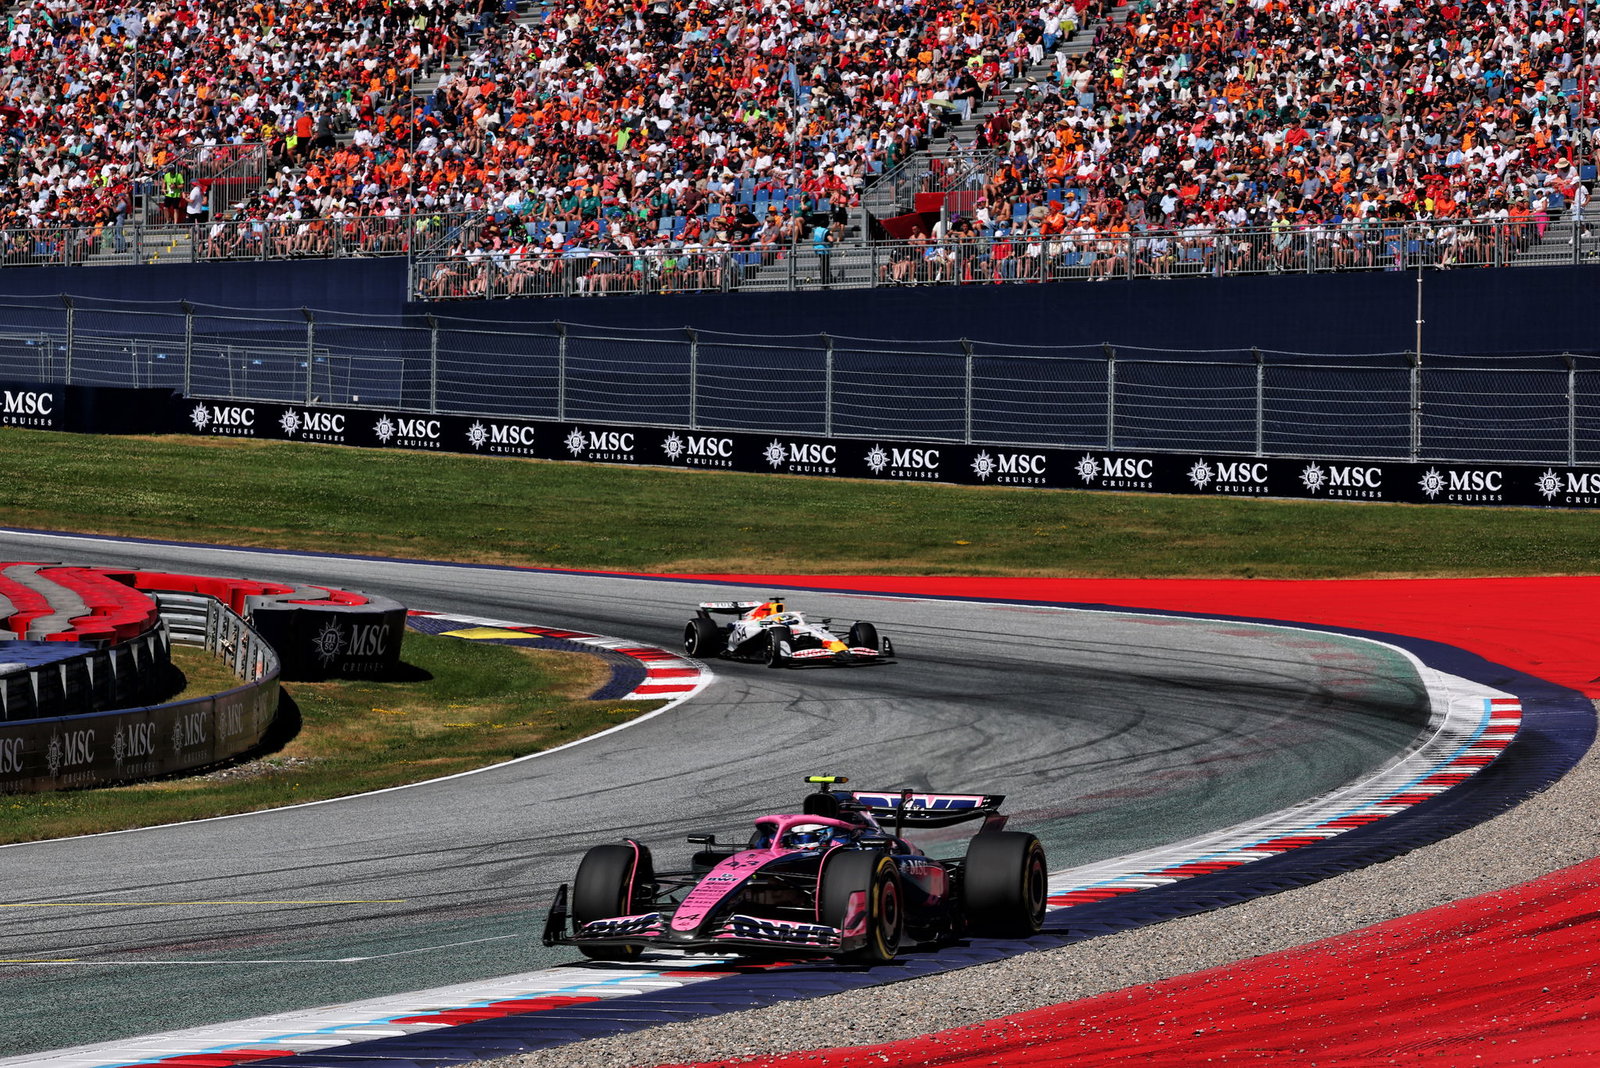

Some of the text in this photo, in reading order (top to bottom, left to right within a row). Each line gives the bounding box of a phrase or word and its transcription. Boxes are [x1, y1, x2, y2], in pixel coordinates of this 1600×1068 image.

[3, 391, 52, 415] MSC
[3, 416, 52, 426] CRUISES
[213, 405, 254, 426] MSC
[302, 412, 345, 432] MSC
[212, 427, 254, 435] CRUISES
[302, 433, 345, 442] CRUISES
[397, 418, 440, 439] MSC
[490, 425, 534, 445] MSC
[397, 439, 440, 448] CRUISES
[490, 446, 534, 454] CRUISES
[589, 431, 634, 451] MSC
[687, 436, 733, 457] MSC
[588, 452, 634, 461] CRUISES
[686, 457, 732, 467] CRUISES
[789, 443, 836, 464] MSC
[891, 448, 939, 469] MSC
[789, 465, 836, 474] CRUISES
[891, 470, 939, 478] CRUISES
[997, 454, 1046, 474] MSC
[1102, 458, 1152, 478] MSC
[1215, 462, 1268, 483] MSC
[997, 476, 1046, 484] CRUISES
[1102, 480, 1153, 488] CRUISES
[1328, 466, 1382, 487] MSC
[1448, 470, 1503, 491] MSC
[1215, 485, 1268, 493] CRUISES
[1328, 489, 1382, 498] CRUISES
[347, 624, 390, 656] MSC
[184, 711, 207, 747] MSC
[227, 703, 244, 736] MSC
[63, 729, 95, 767] MSC
[128, 722, 156, 757] MSC
[908, 859, 929, 876] MSC
